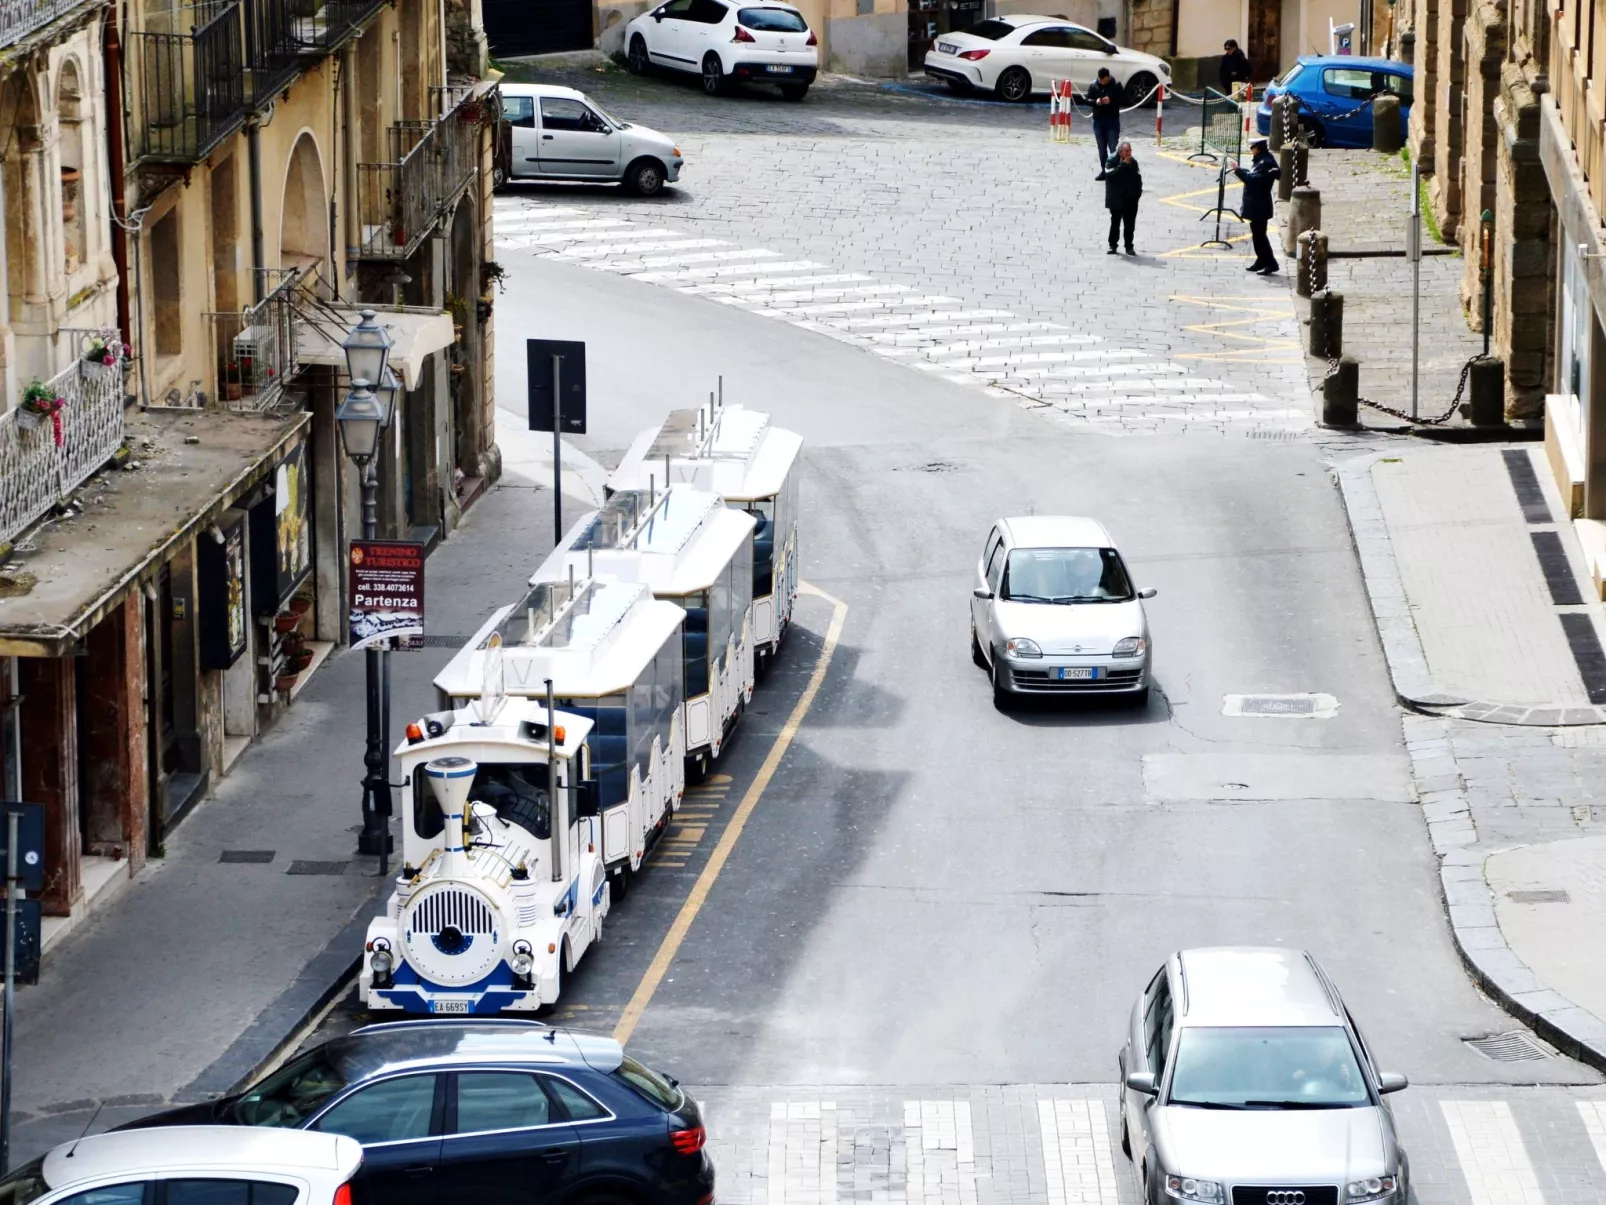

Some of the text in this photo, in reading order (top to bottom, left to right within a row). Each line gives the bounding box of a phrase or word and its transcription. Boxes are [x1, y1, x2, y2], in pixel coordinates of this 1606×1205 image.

[1342, 37, 1349, 47] P
[357, 583, 371, 591] cell.
[355, 594, 418, 607] Partenza
